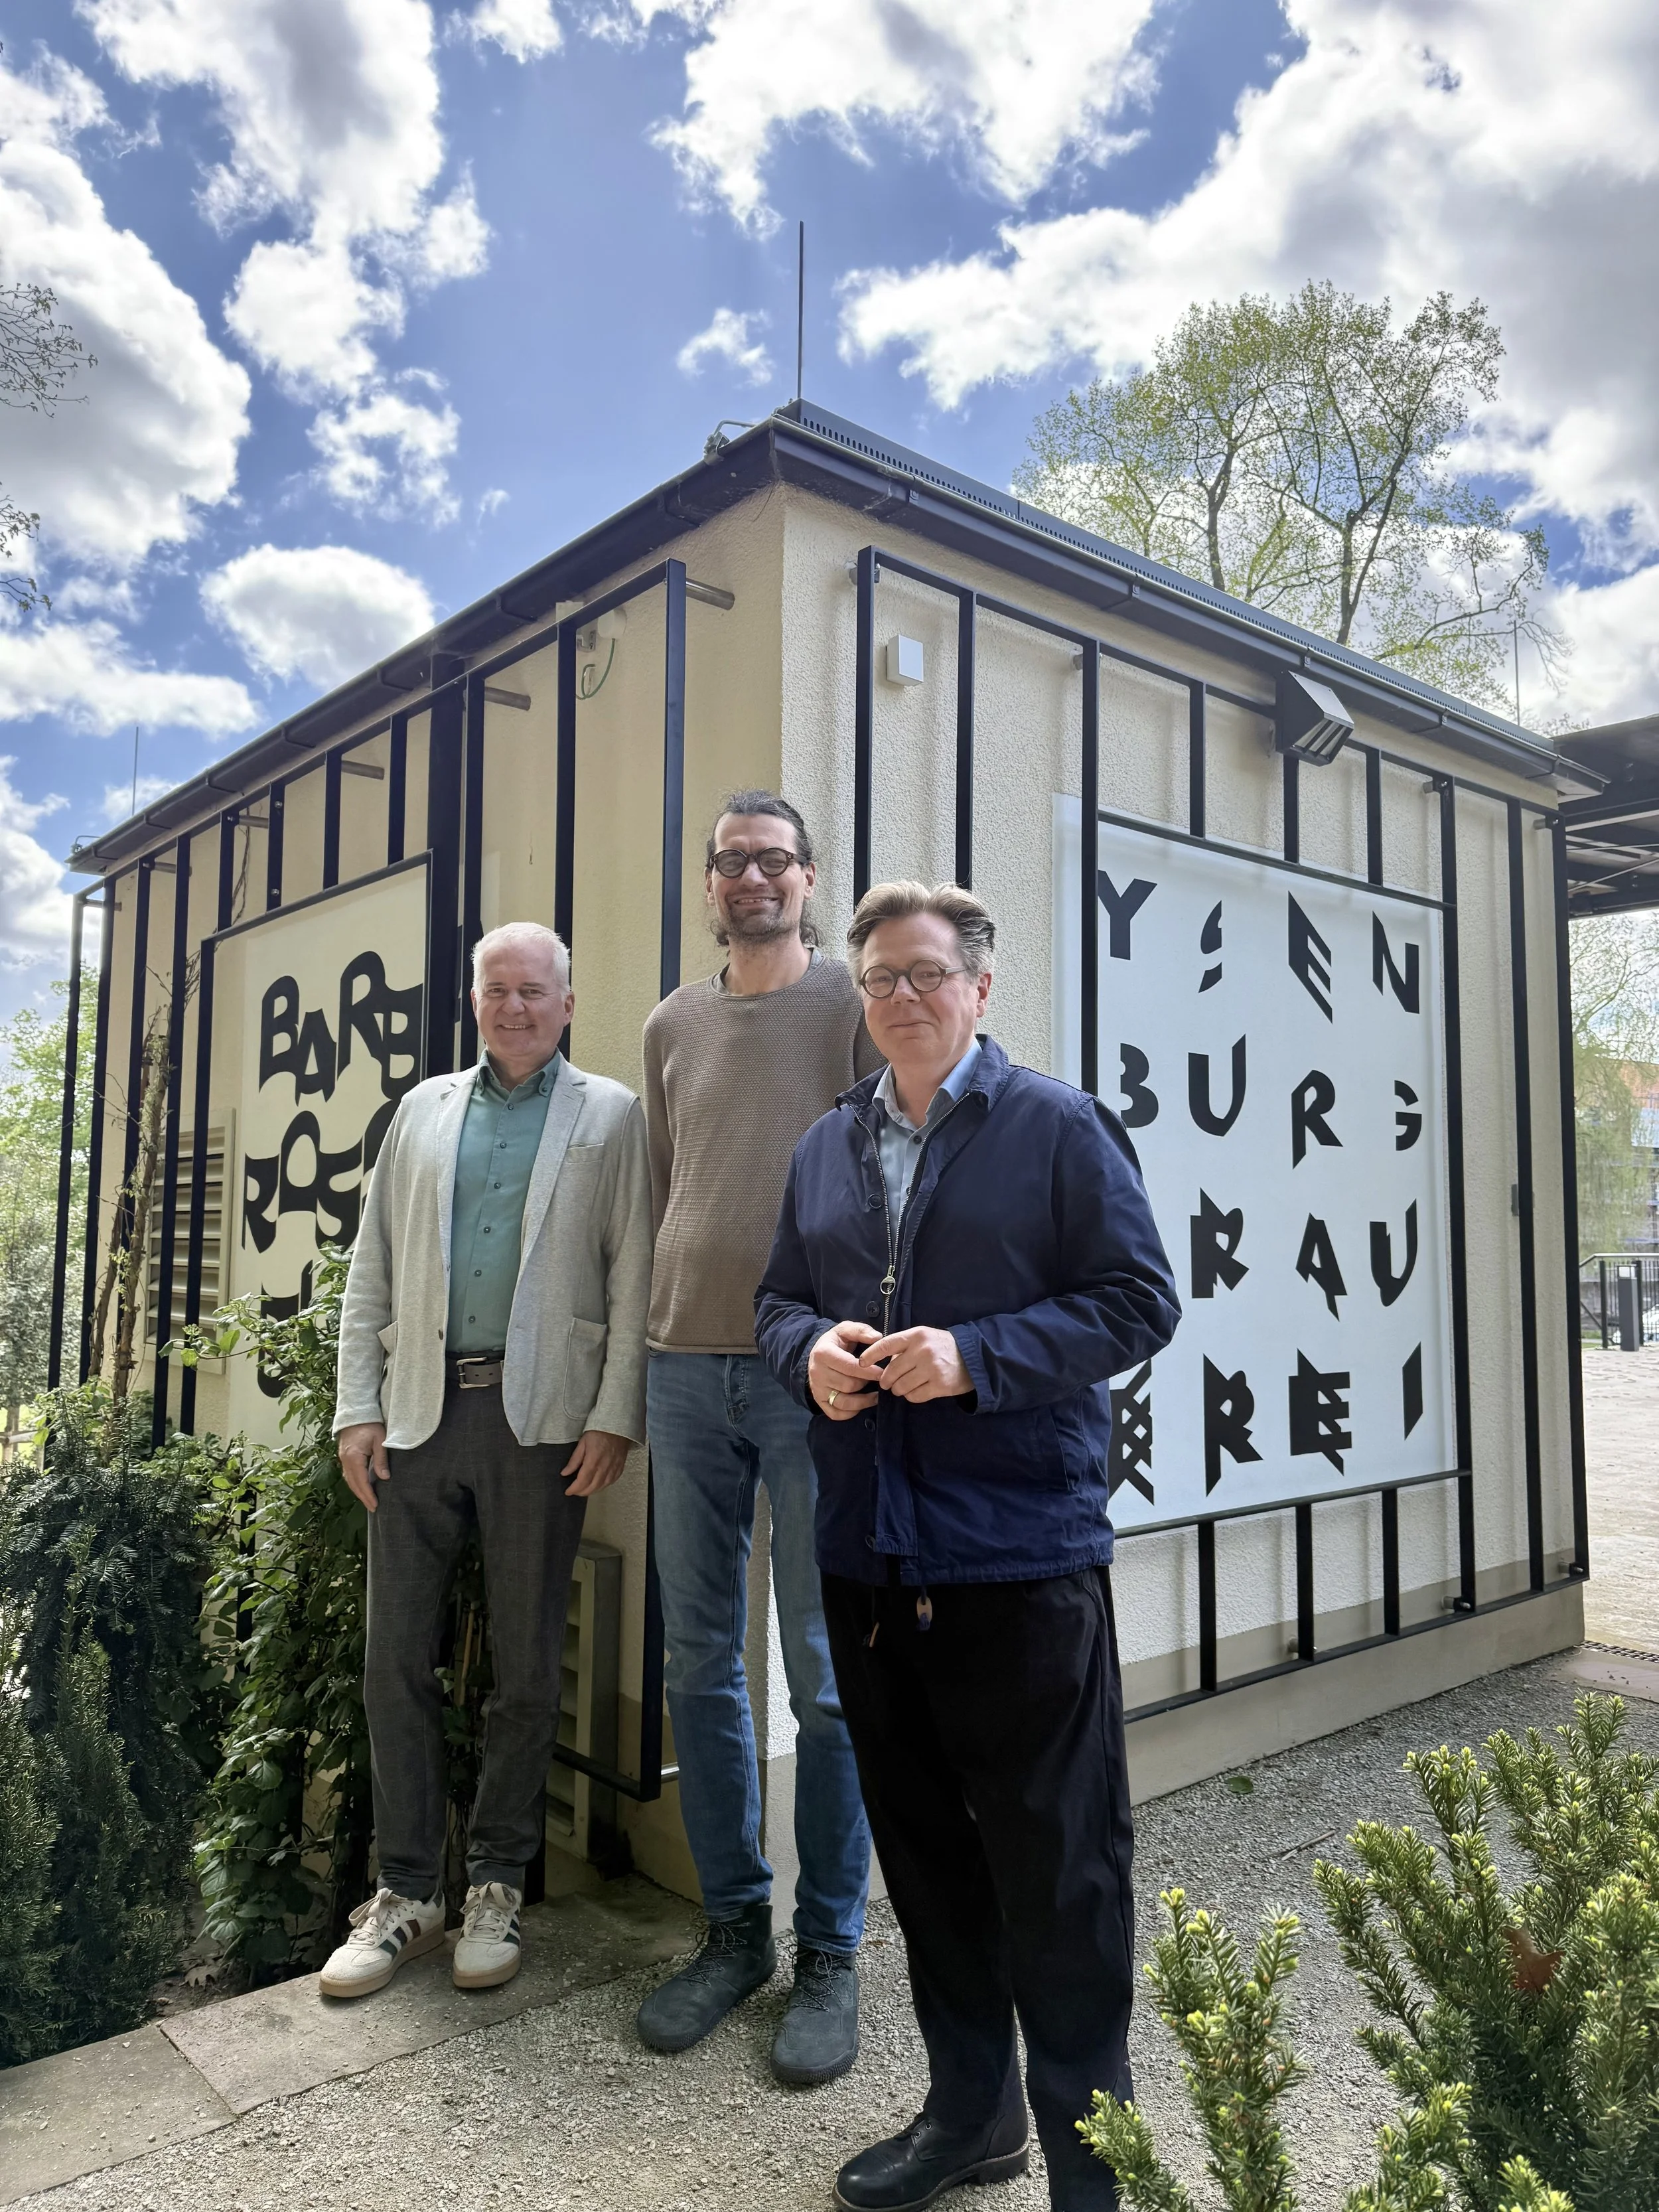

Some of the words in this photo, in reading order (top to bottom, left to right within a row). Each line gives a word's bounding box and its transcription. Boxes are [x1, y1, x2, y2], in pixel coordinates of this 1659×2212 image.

[259, 950, 425, 1107] BARB
[1120, 1033, 1423, 1170] BURG
[242, 1100, 402, 1254] ROS
[1190, 1187, 1419, 1322] RAU
